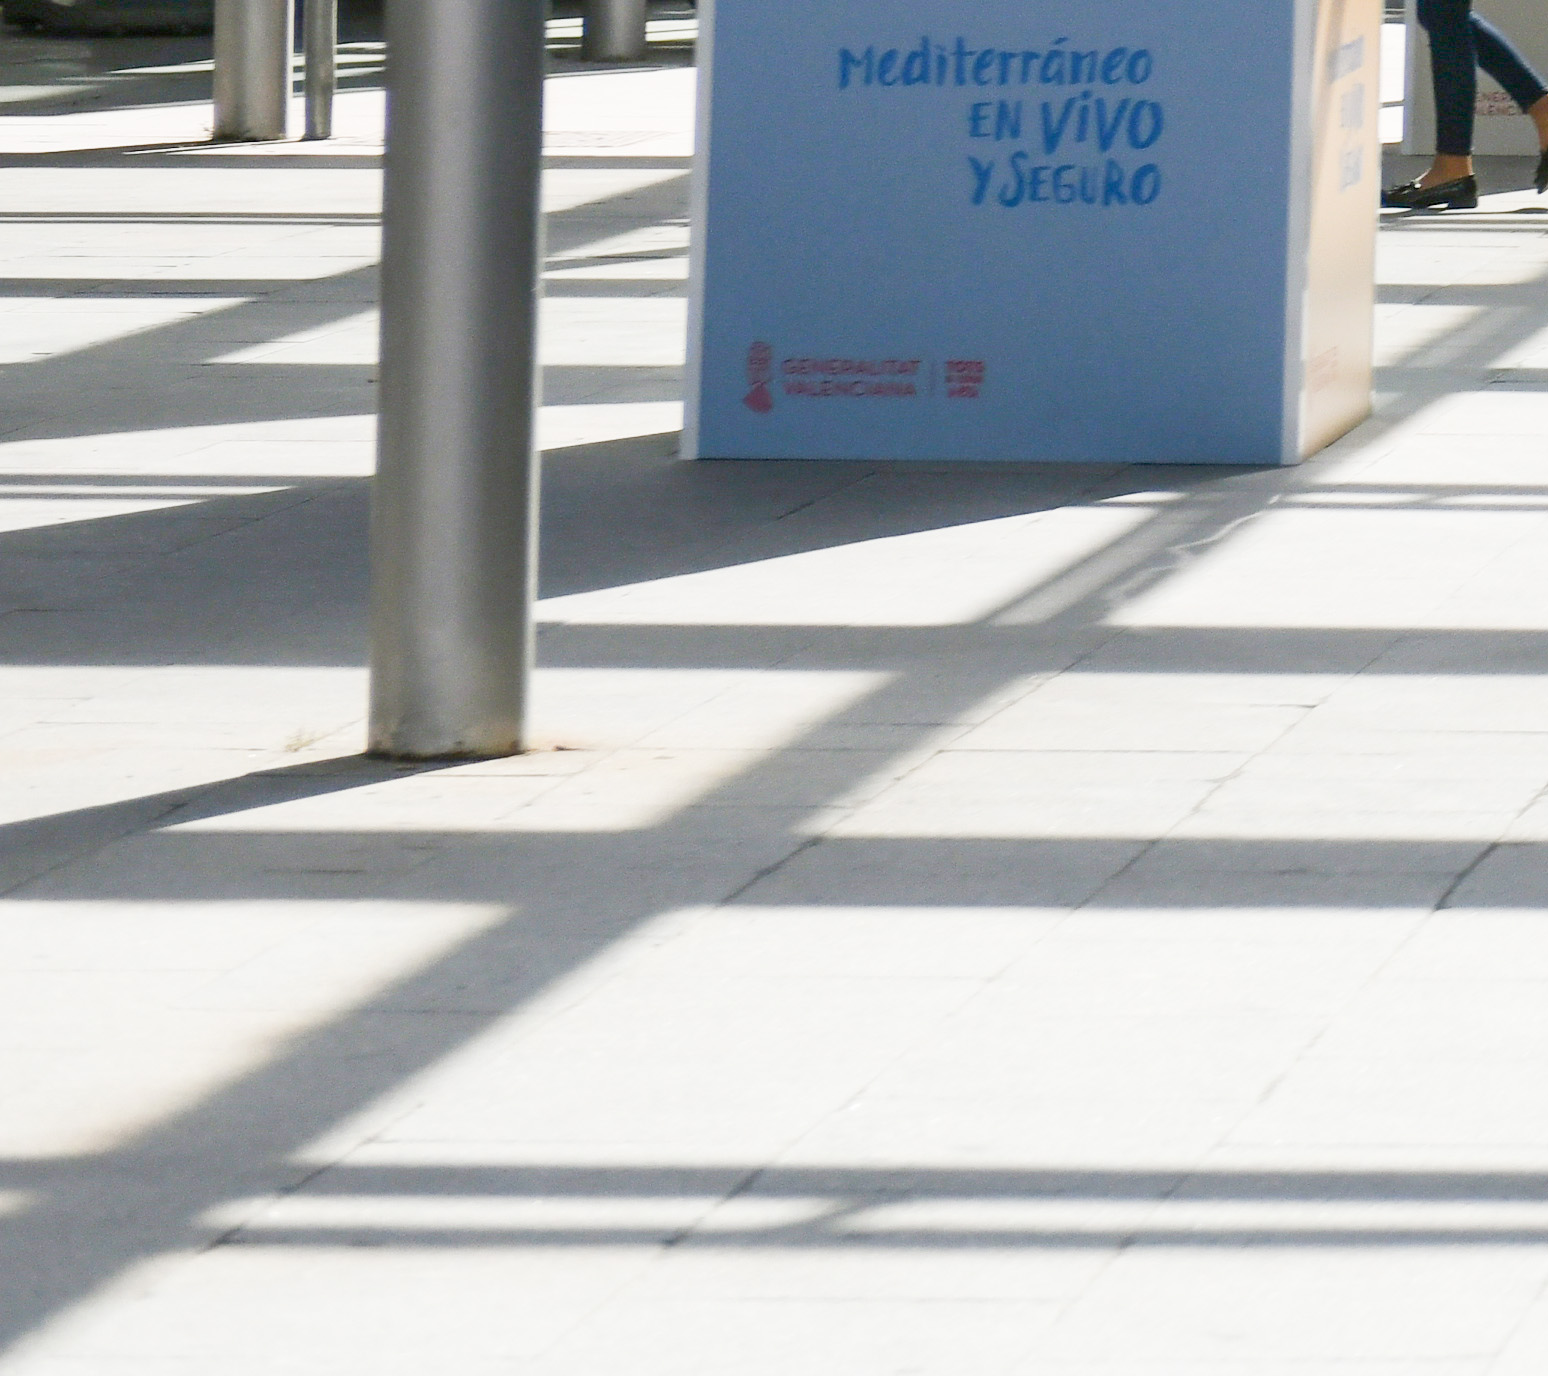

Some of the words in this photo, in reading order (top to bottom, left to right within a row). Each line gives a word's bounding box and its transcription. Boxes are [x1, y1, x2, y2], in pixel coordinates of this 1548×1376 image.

[838, 37, 1153, 90] Mediterráneo
[968, 100, 1022, 141] EN
[968, 155, 994, 205] Y
